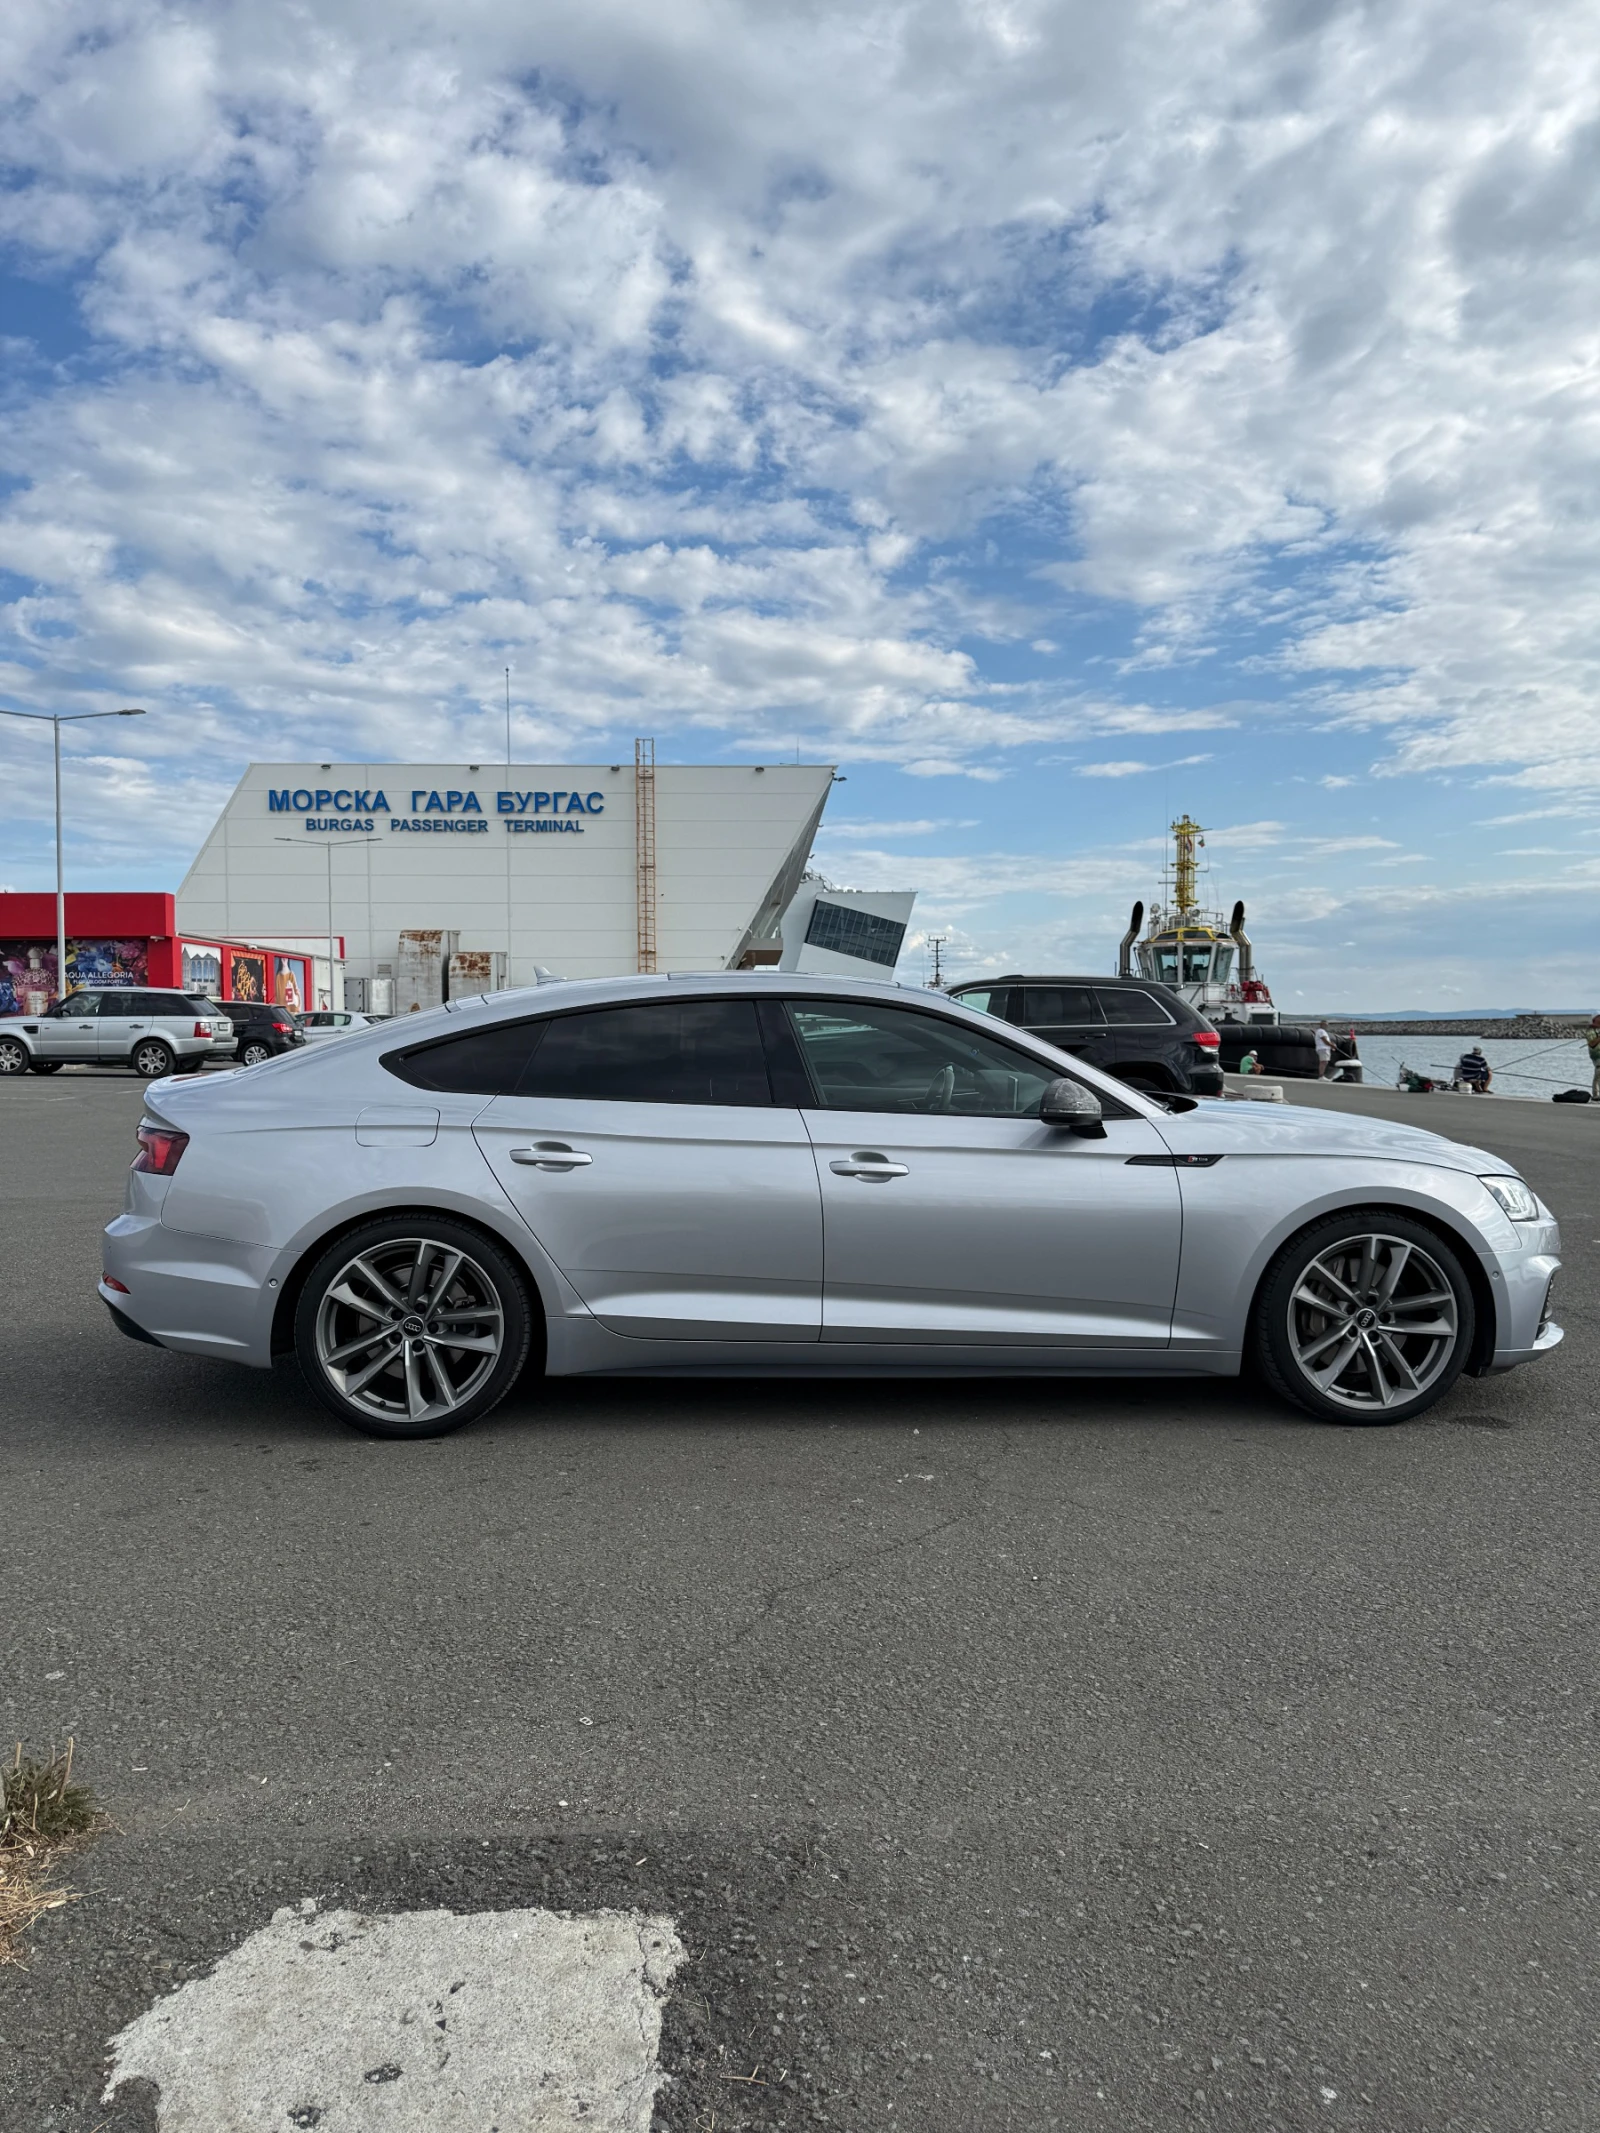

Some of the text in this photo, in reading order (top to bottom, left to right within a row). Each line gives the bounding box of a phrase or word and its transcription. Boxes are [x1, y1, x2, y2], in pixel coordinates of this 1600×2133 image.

[268, 789, 605, 814] МОРСКА ГАРА БУРГАС
[306, 818, 584, 833] BURGAS PASSENGER TERMINAL
[65, 971, 133, 979] AQUA ALLEGORIA
